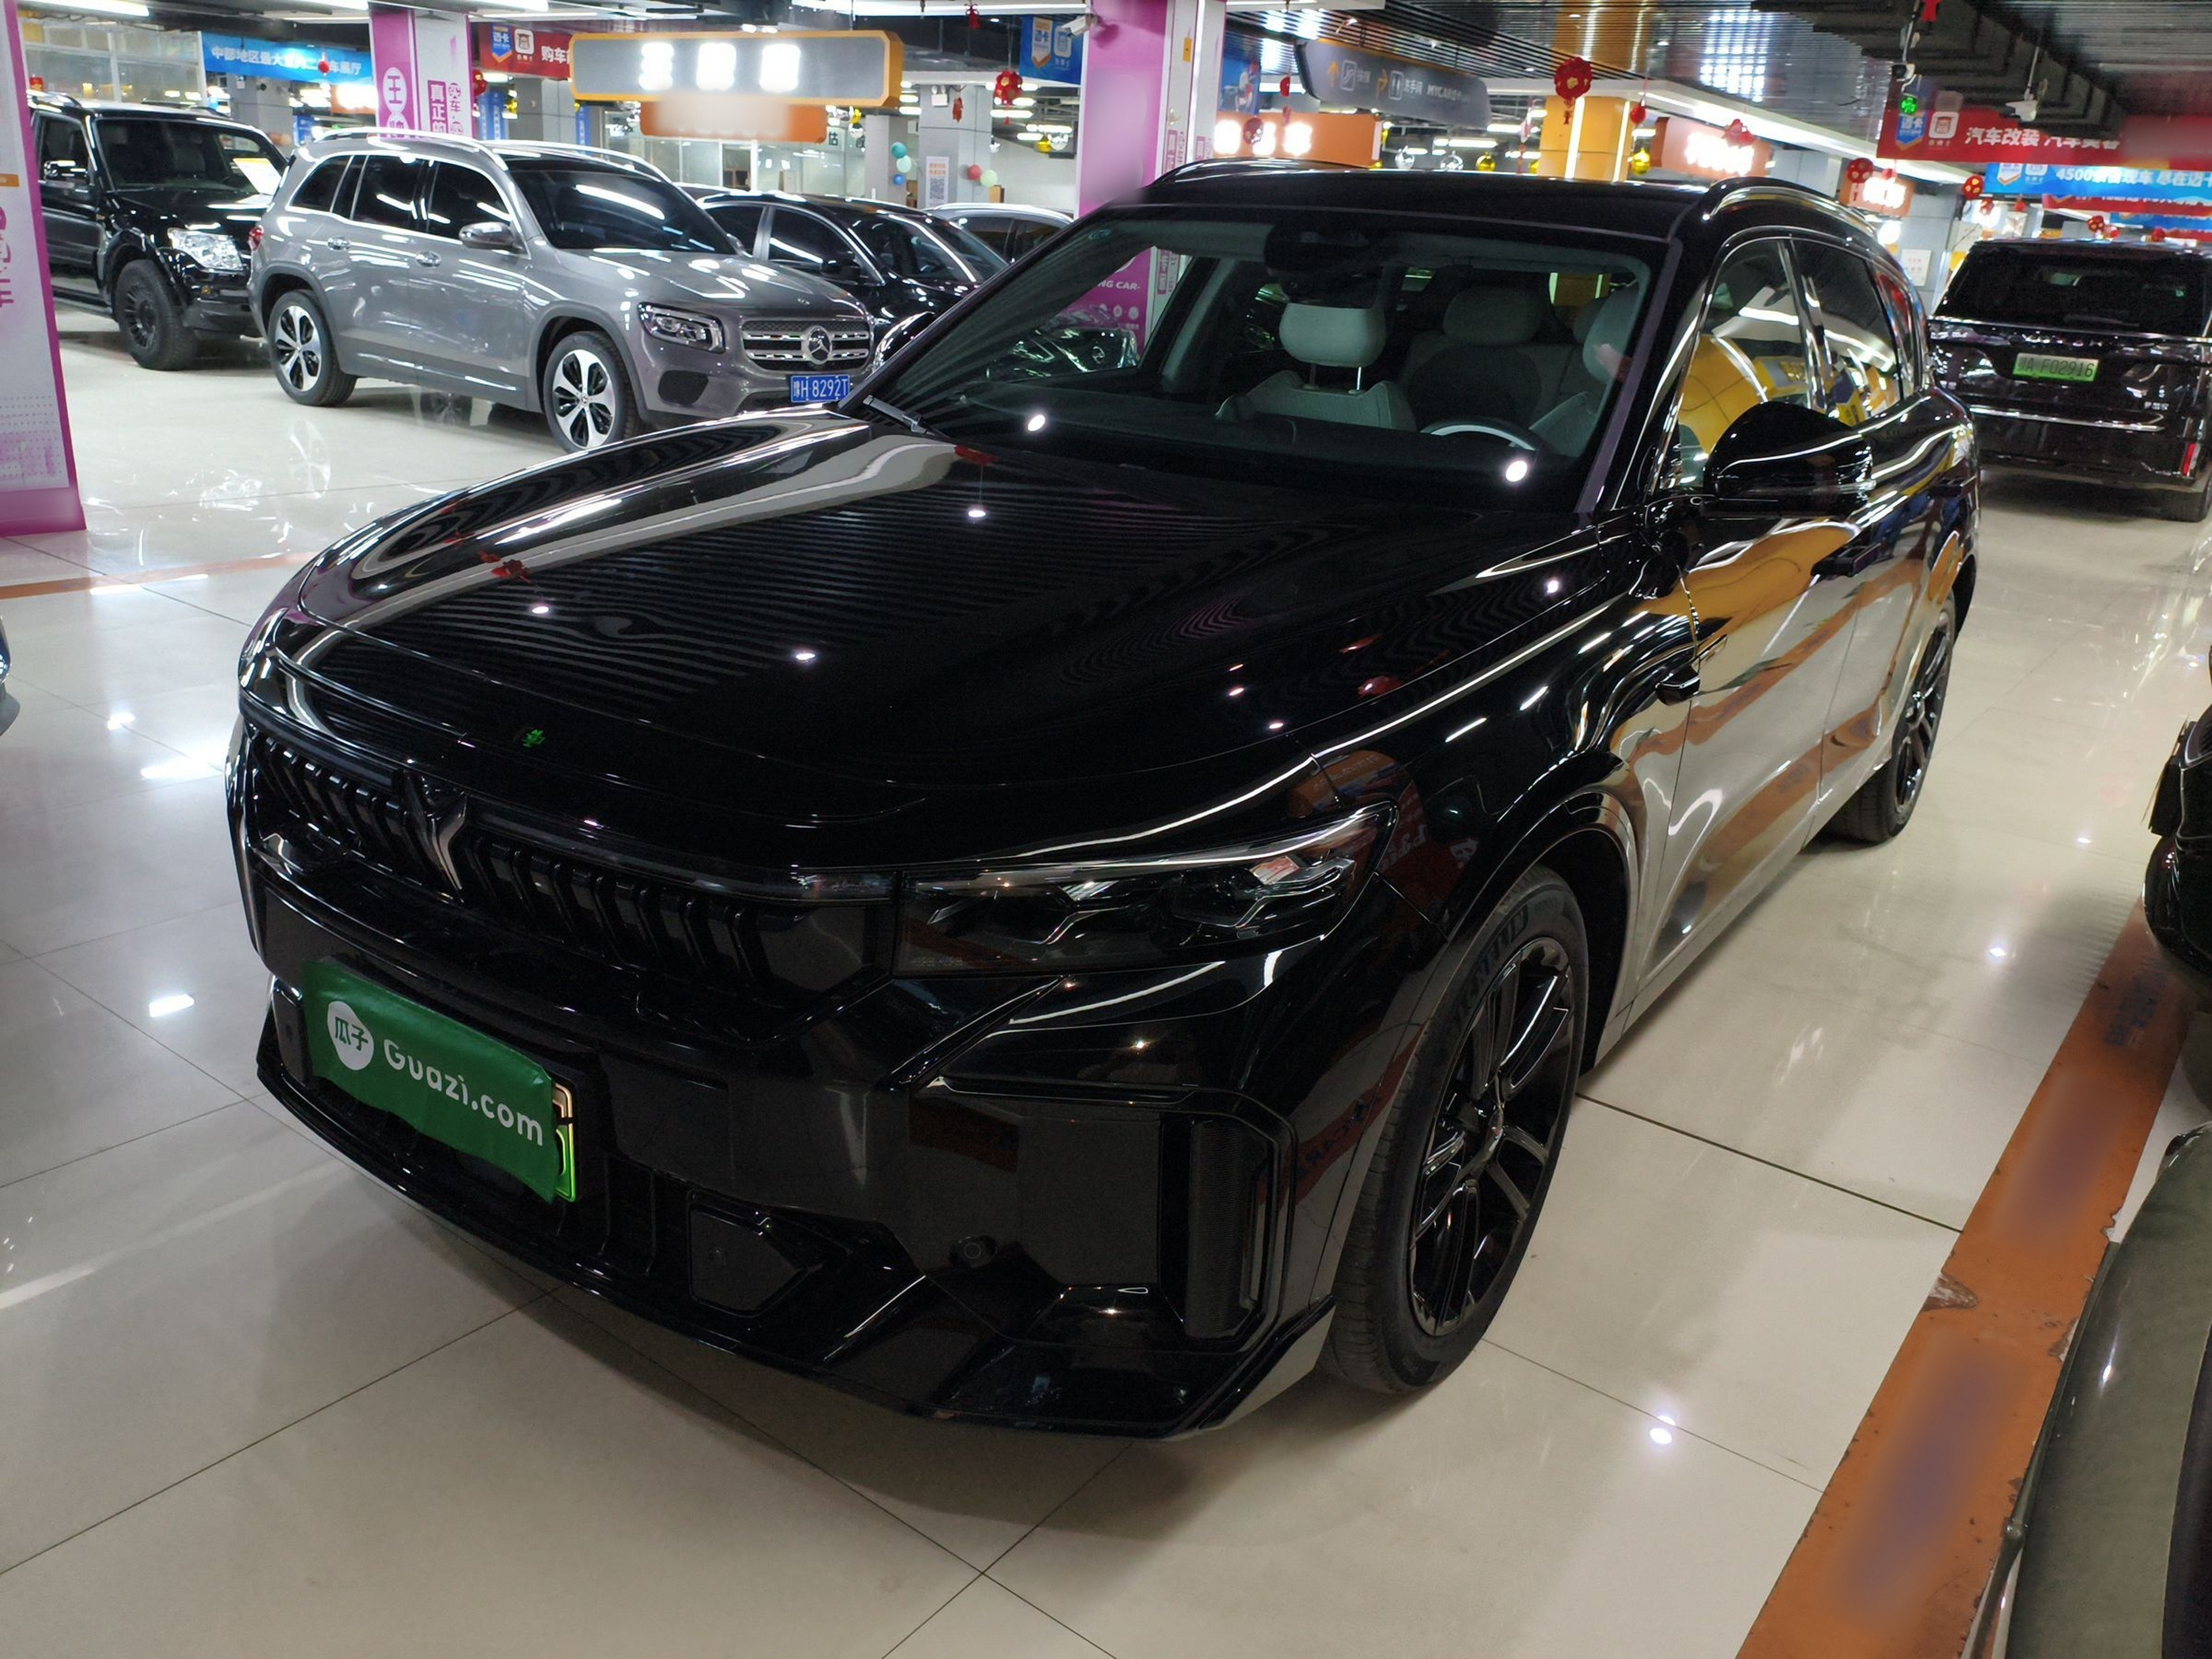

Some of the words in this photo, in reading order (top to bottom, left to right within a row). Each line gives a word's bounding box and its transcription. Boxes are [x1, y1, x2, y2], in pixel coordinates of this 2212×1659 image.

[541, 46, 570, 64] 购车
[1965, 127, 2041, 147] 汽车改装
[335, 1017, 369, 1051] 瓜子
[383, 1039, 543, 1146] Guazi.com
